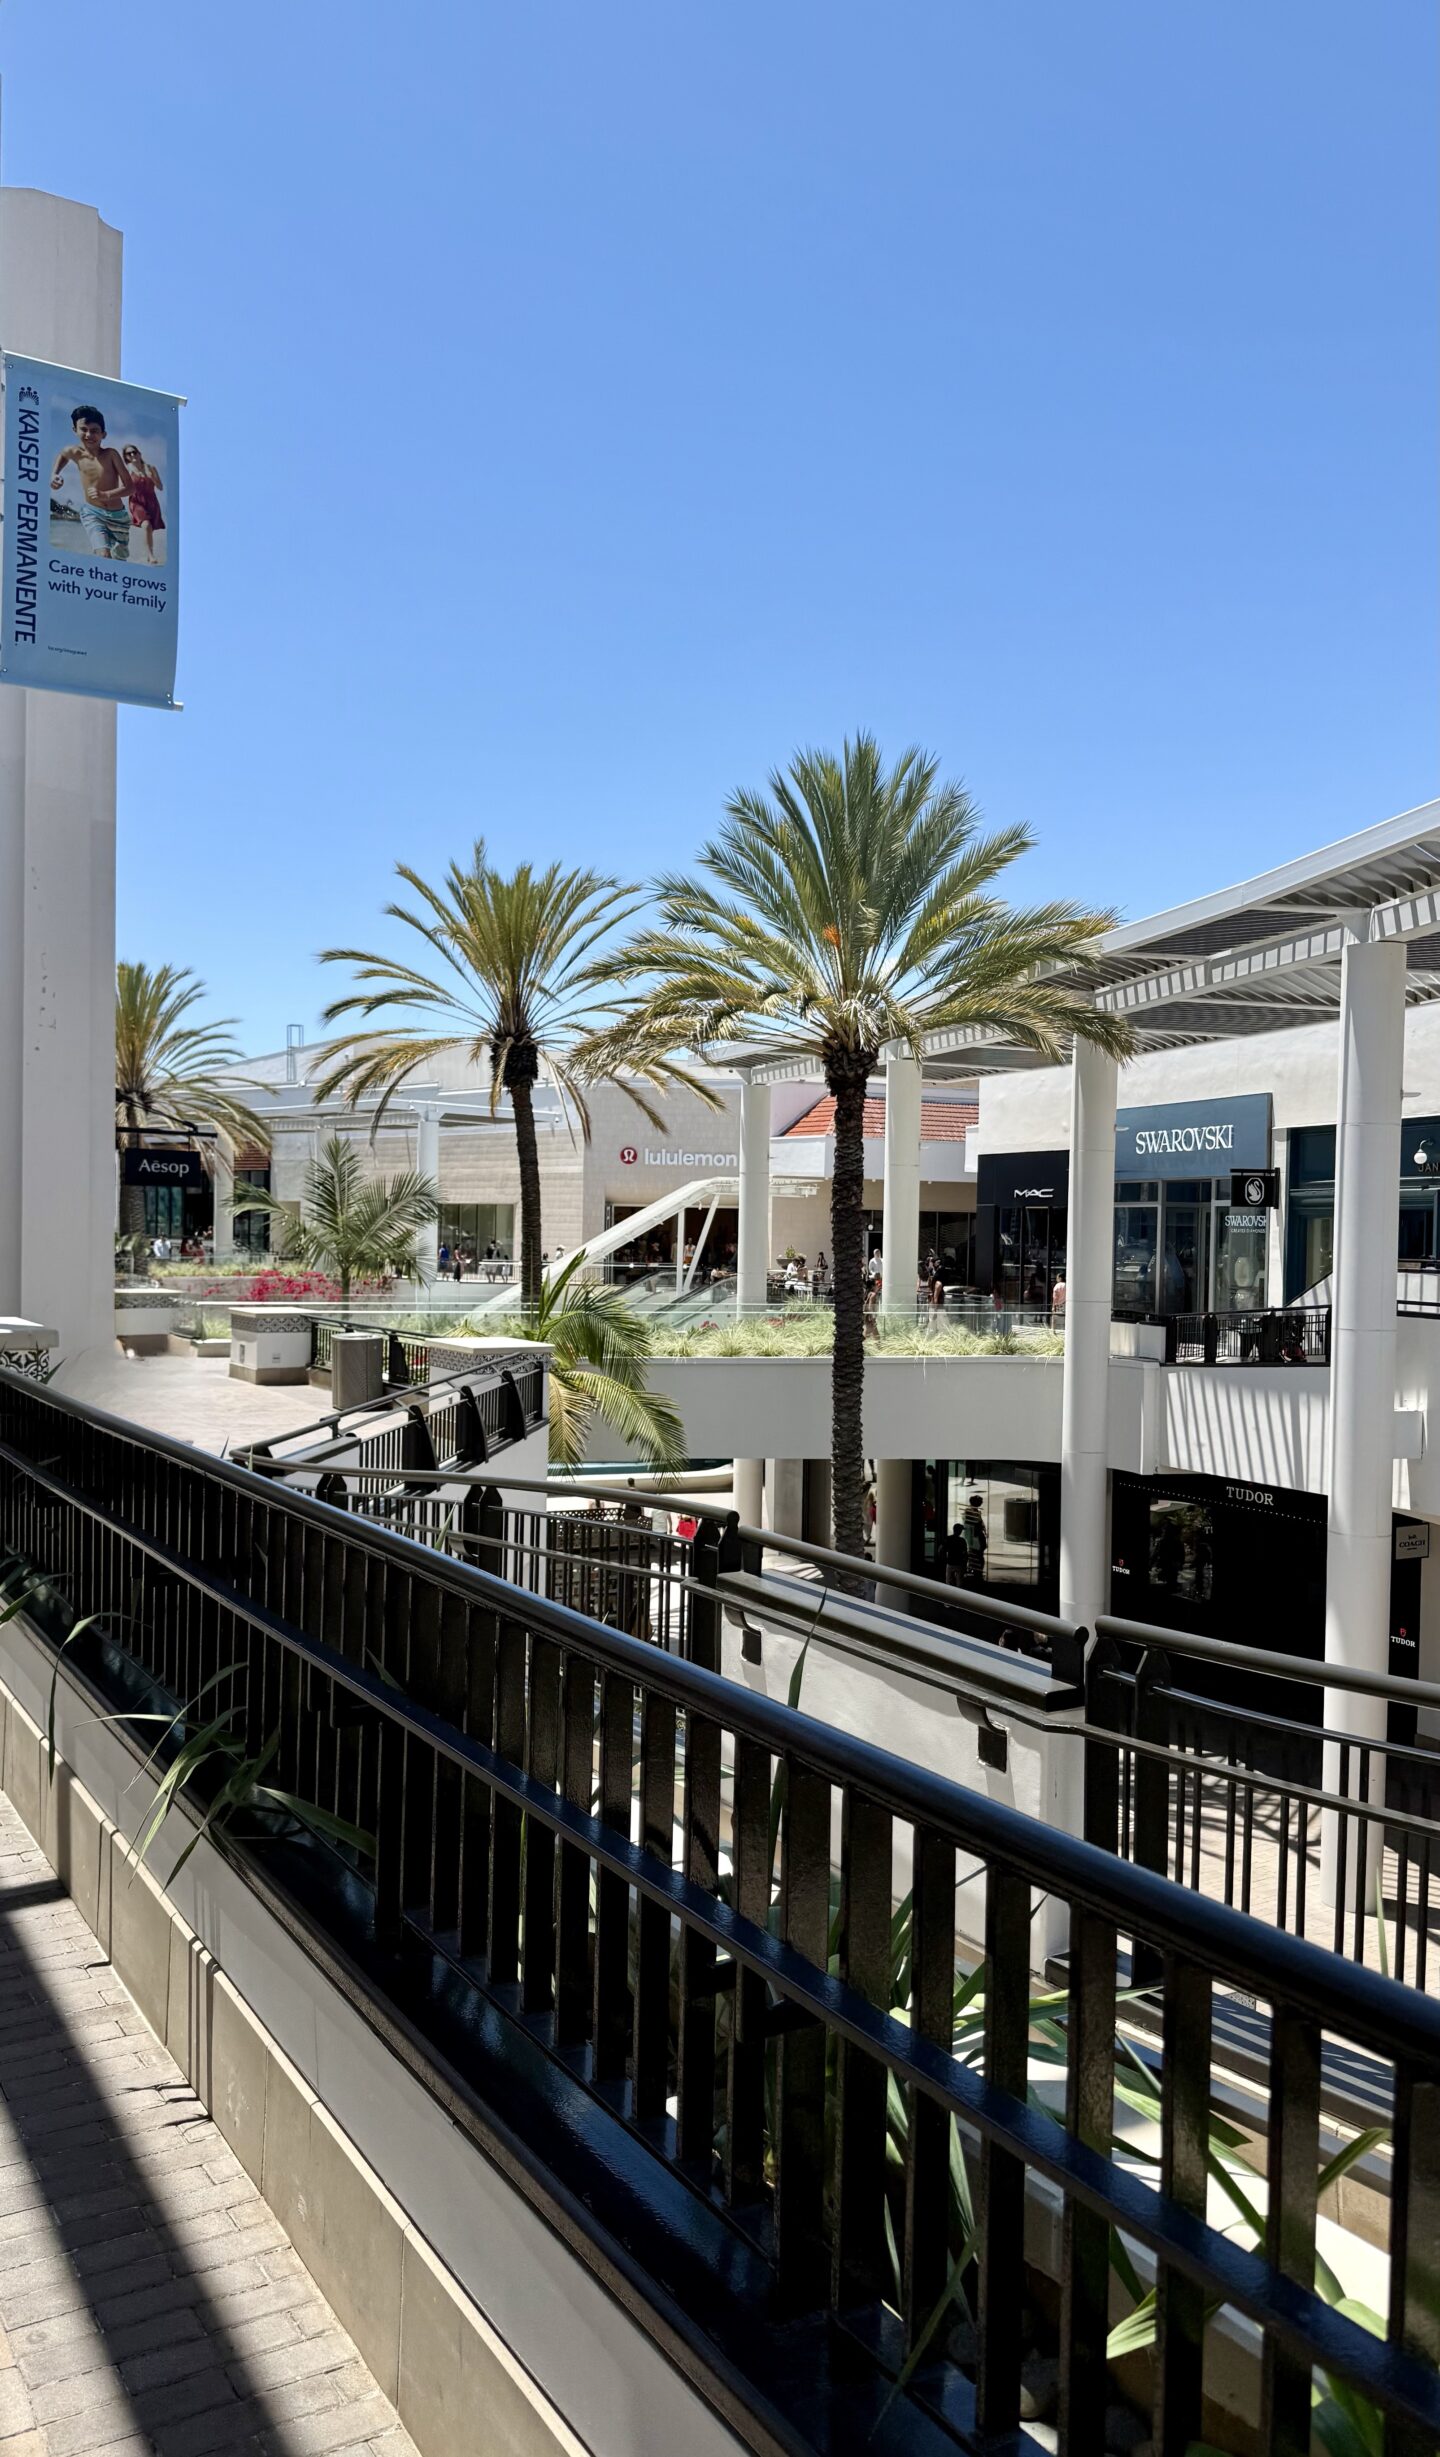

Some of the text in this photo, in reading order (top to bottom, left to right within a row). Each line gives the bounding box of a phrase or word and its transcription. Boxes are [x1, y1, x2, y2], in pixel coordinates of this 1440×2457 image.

[15, 408, 39, 645] KAISER PERMANENTE
[48, 559, 167, 592] Care that grows
[48, 580, 166, 612] with your family
[1135, 1124, 1233, 1155] SWAROVSKI
[644, 1148, 738, 1167] lululemon
[1224, 1215, 1266, 1227] SWAROVSK
[1226, 1486, 1275, 1506] TUDOR
[1112, 1565, 1131, 1575] TUDOR
[1390, 1635, 1416, 1648] TUDOR
